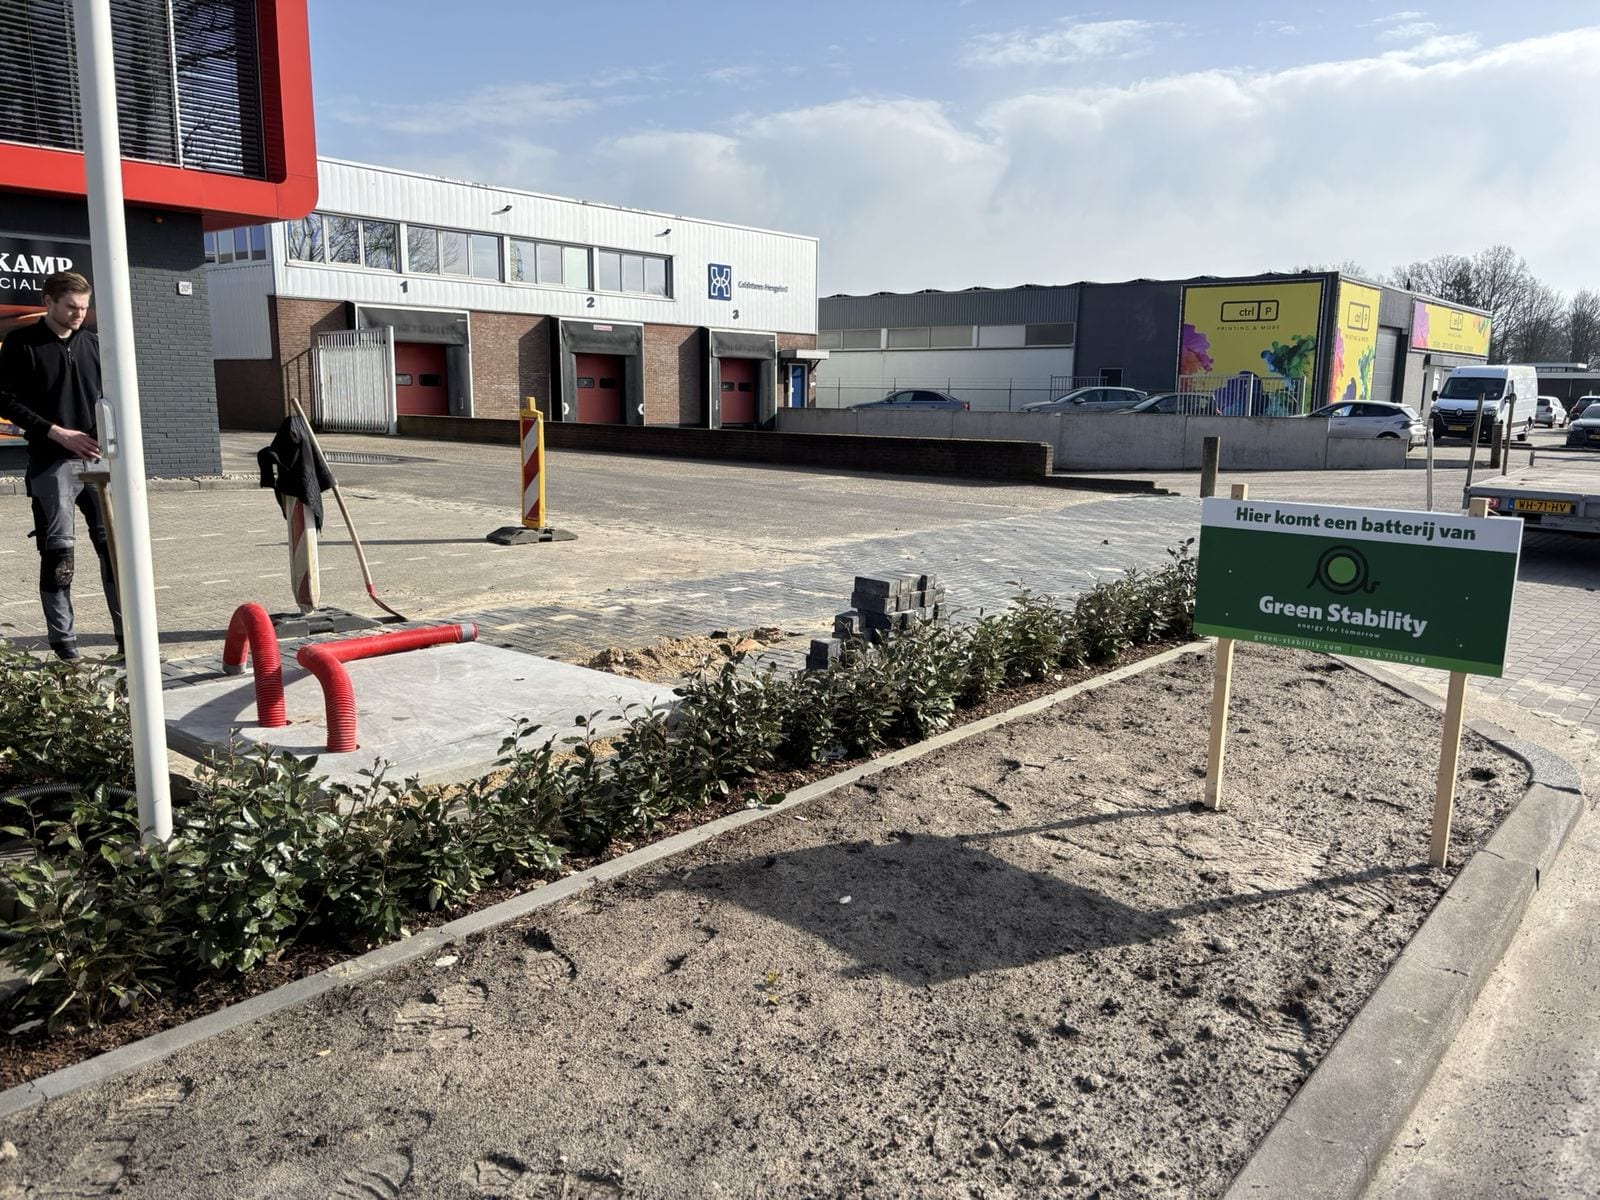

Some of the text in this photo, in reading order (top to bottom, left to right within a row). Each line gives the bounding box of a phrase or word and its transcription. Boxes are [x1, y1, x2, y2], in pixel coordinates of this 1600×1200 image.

[0, 277, 46, 291] CIAL
[400, 280, 408, 293] 1
[586, 296, 595, 308] 2
[732, 309, 739, 320] 3
[1239, 307, 1272, 317] ctrl P
[1519, 501, 1567, 512] WH-71-HV
[1236, 506, 1476, 541] Hier komt een batterij van
[1259, 595, 1428, 638] Green Stability
[1297, 623, 1323, 632] energy
[1341, 628, 1380, 638] tomorrow
[1254, 634, 1342, 651] green-stability.com
